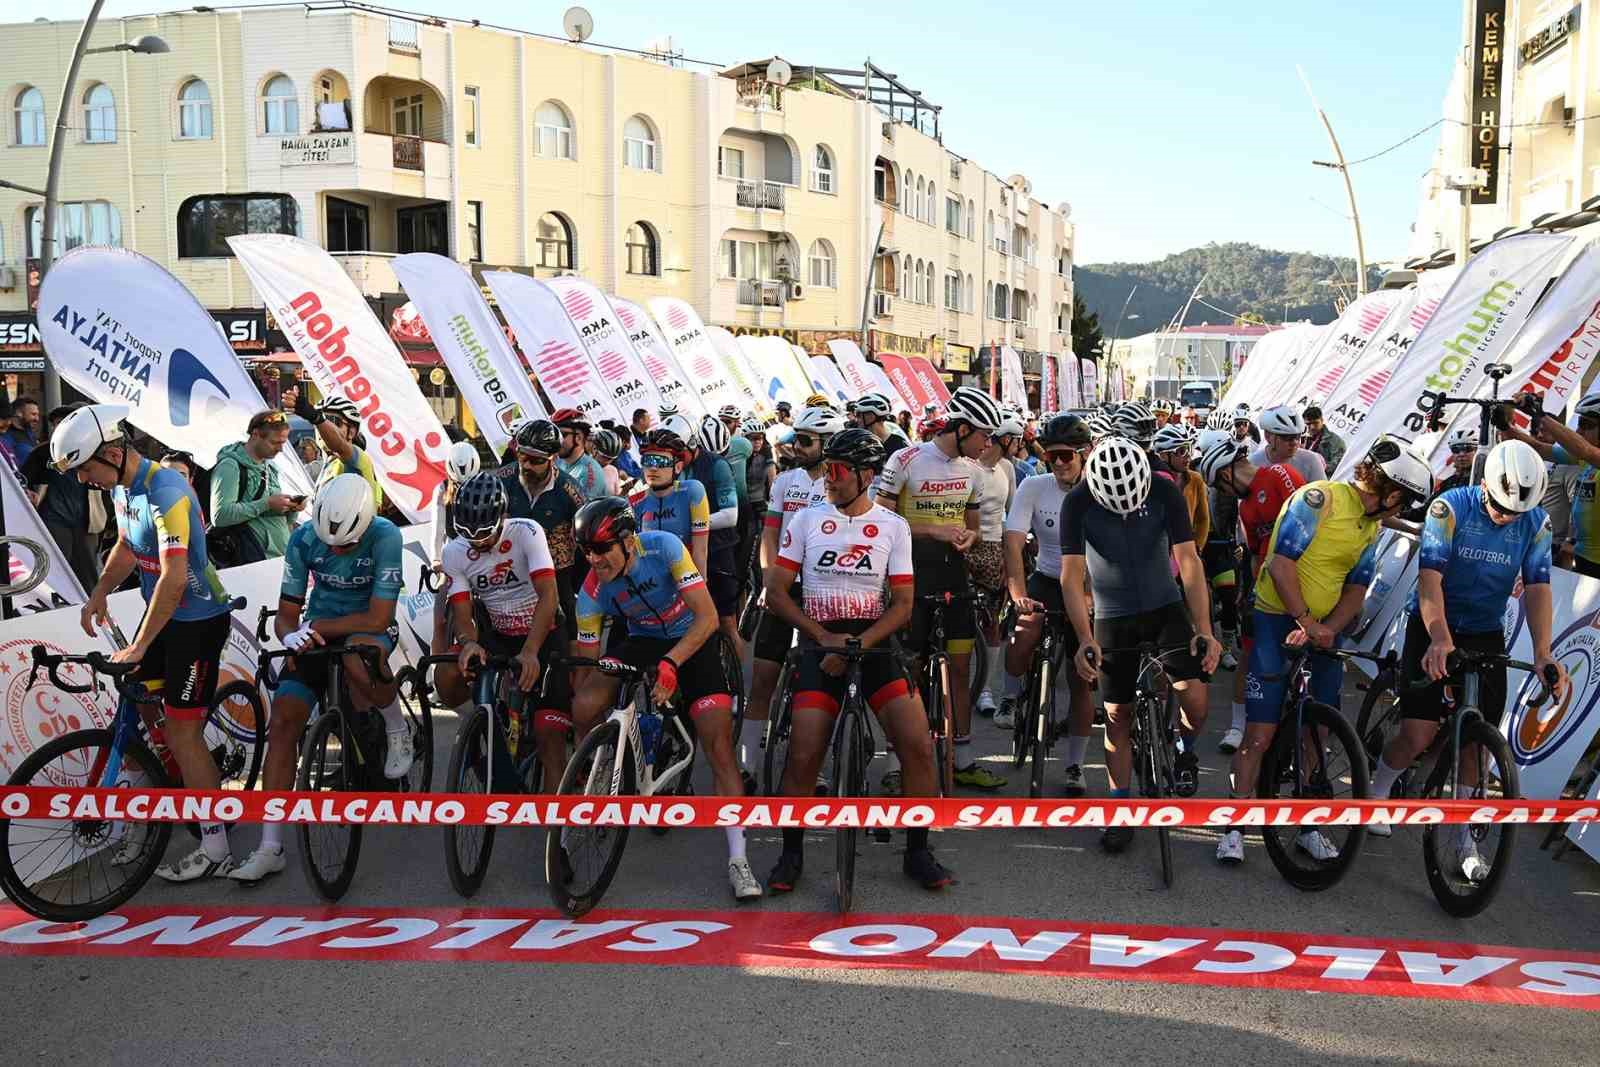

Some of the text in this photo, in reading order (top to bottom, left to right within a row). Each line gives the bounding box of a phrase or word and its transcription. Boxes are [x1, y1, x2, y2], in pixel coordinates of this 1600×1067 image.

[1481, 12, 1499, 98] KEMER
[1477, 310, 1509, 353] ticaret
[1403, 280, 1520, 433] agtohum
[920, 480, 967, 494] Asperox
[916, 501, 941, 510] bike
[1457, 546, 1512, 566] VELOTERRA
[579, 631, 597, 641] MK
[48, 793, 244, 823] SALCANO
[262, 796, 466, 826] SALCANO
[484, 800, 696, 828] SALCANO
[714, 801, 936, 829] SALCANO
[954, 804, 1186, 829] SALCANO
[1203, 807, 1446, 826] SALCANO
[0, 915, 732, 952] SALCANO
[808, 924, 1600, 996] SALCANO
